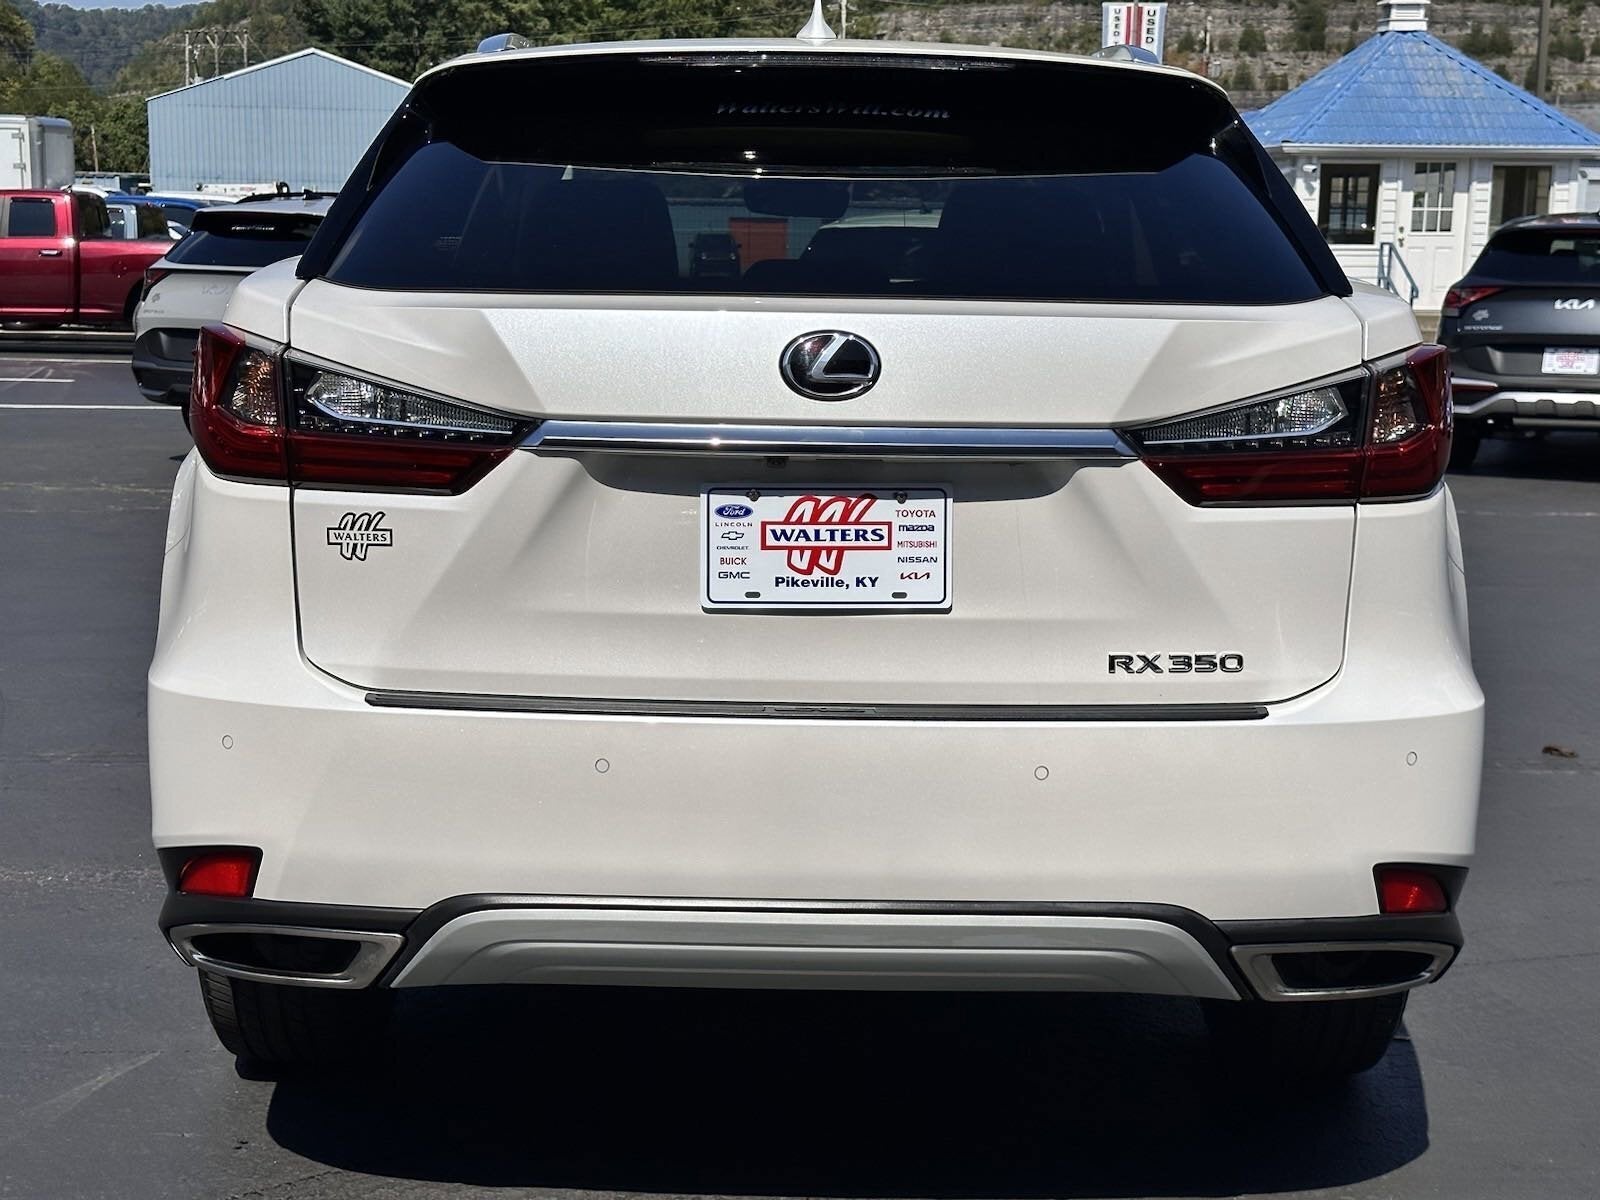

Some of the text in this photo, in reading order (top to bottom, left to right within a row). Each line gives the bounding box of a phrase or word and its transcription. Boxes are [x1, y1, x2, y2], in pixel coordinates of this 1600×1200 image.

[1113, 8, 1121, 37] USED
[1145, 9, 1157, 44] USED
[1554, 298, 1595, 310] KIA
[722, 504, 746, 516] Ford
[895, 509, 936, 518] TOYOTA
[333, 532, 388, 542] WALTERS
[769, 528, 885, 542] WALTERS
[897, 540, 938, 548] MITSUBISHI
[719, 557, 747, 565] BUICK
[718, 571, 751, 579] GMC
[900, 572, 931, 580] KIA
[774, 576, 879, 590] Pikeville, KY
[1108, 654, 1244, 674] RX 350
